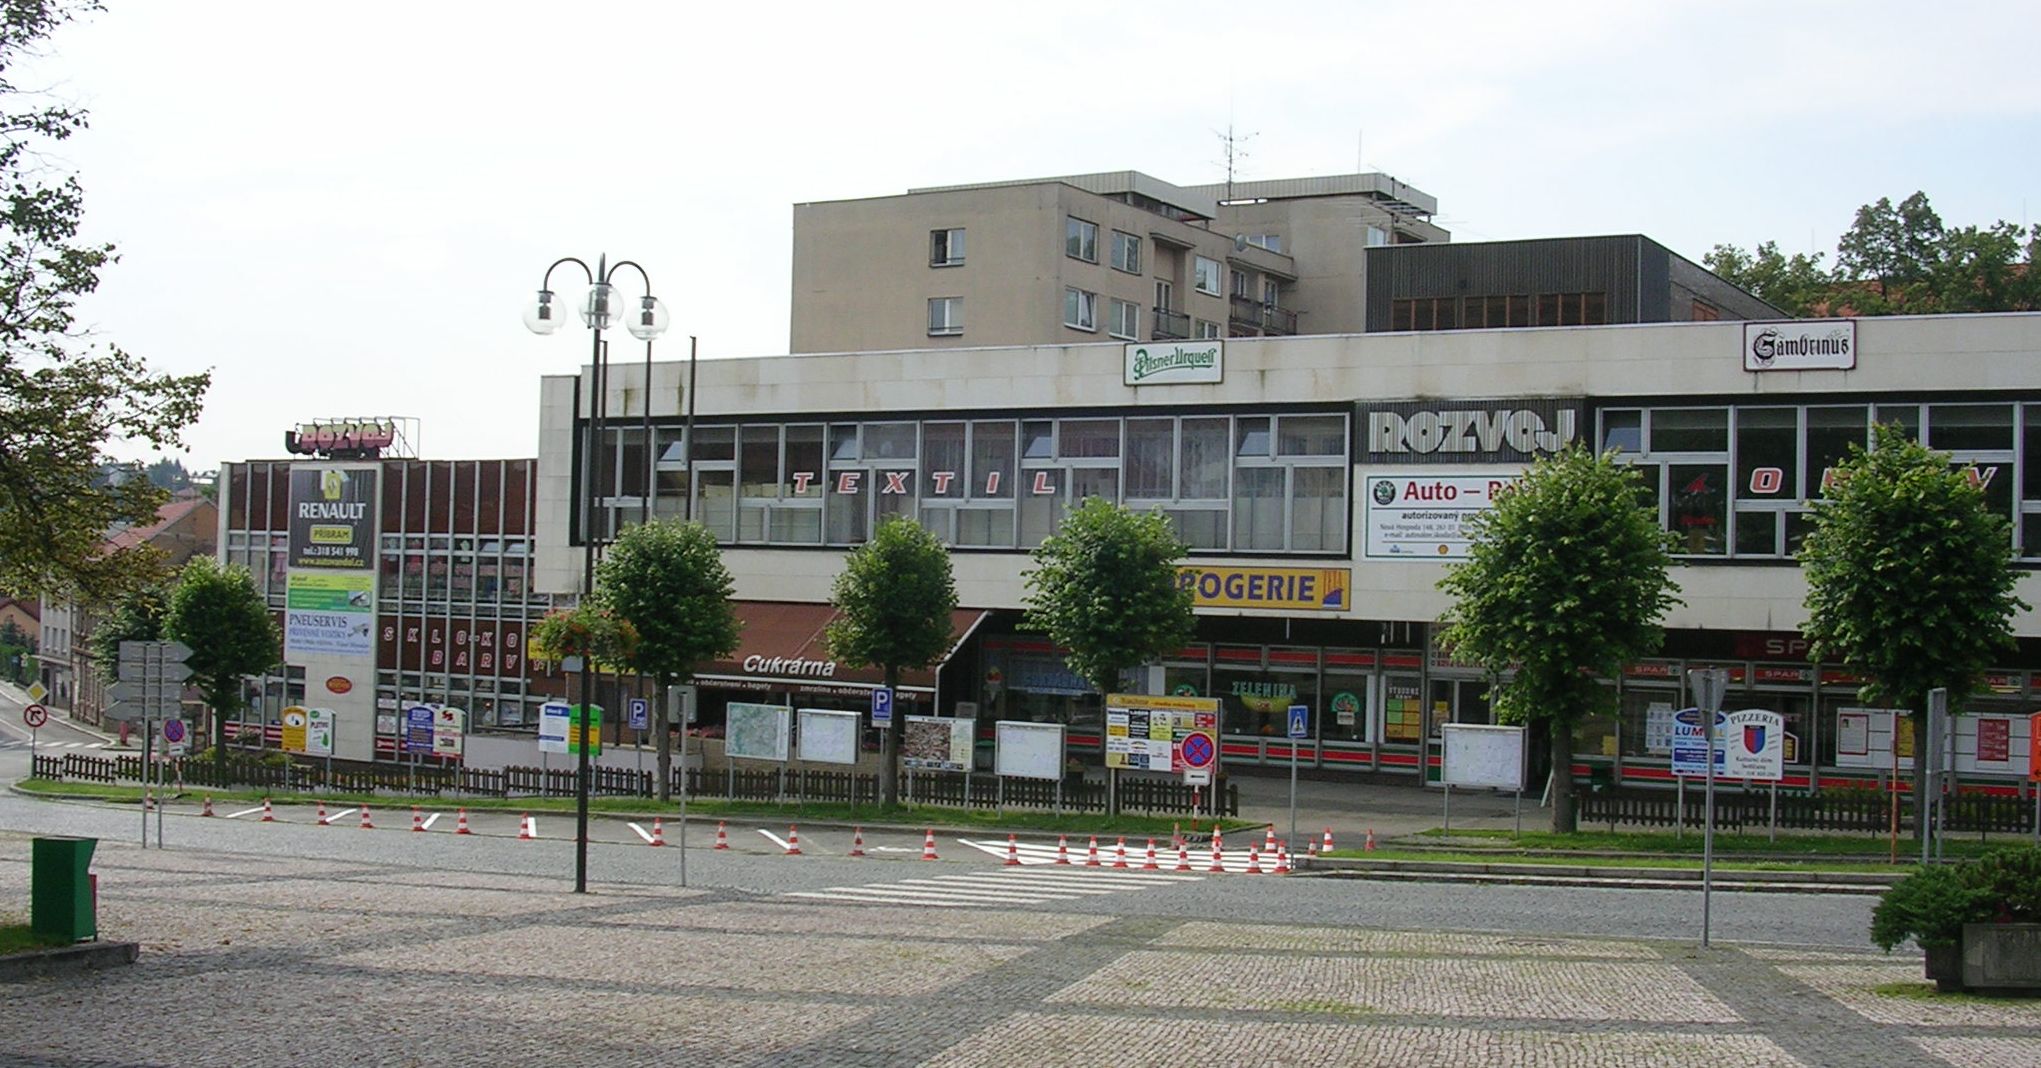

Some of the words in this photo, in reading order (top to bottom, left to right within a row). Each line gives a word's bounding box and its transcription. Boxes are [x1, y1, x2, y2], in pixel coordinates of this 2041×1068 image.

[1133, 348, 1174, 380] Pilsner
[1175, 346, 1217, 369] Urquell
[1369, 409, 1576, 454] ROZVOJ
[793, 471, 1056, 495] TEXTIL
[1404, 481, 1457, 501] Auto
[298, 502, 367, 520] RENAULT
[1402, 510, 1459, 521] autorizovaný
[289, 613, 348, 628] PNEUSERVIS
[743, 654, 836, 676] Cukrárna
[1634, 665, 1668, 674] SPAR
[1765, 669, 1800, 679] SPAR
[876, 691, 888, 710] P
[633, 702, 644, 719] P
[1730, 713, 1780, 727] PIZZERIA
